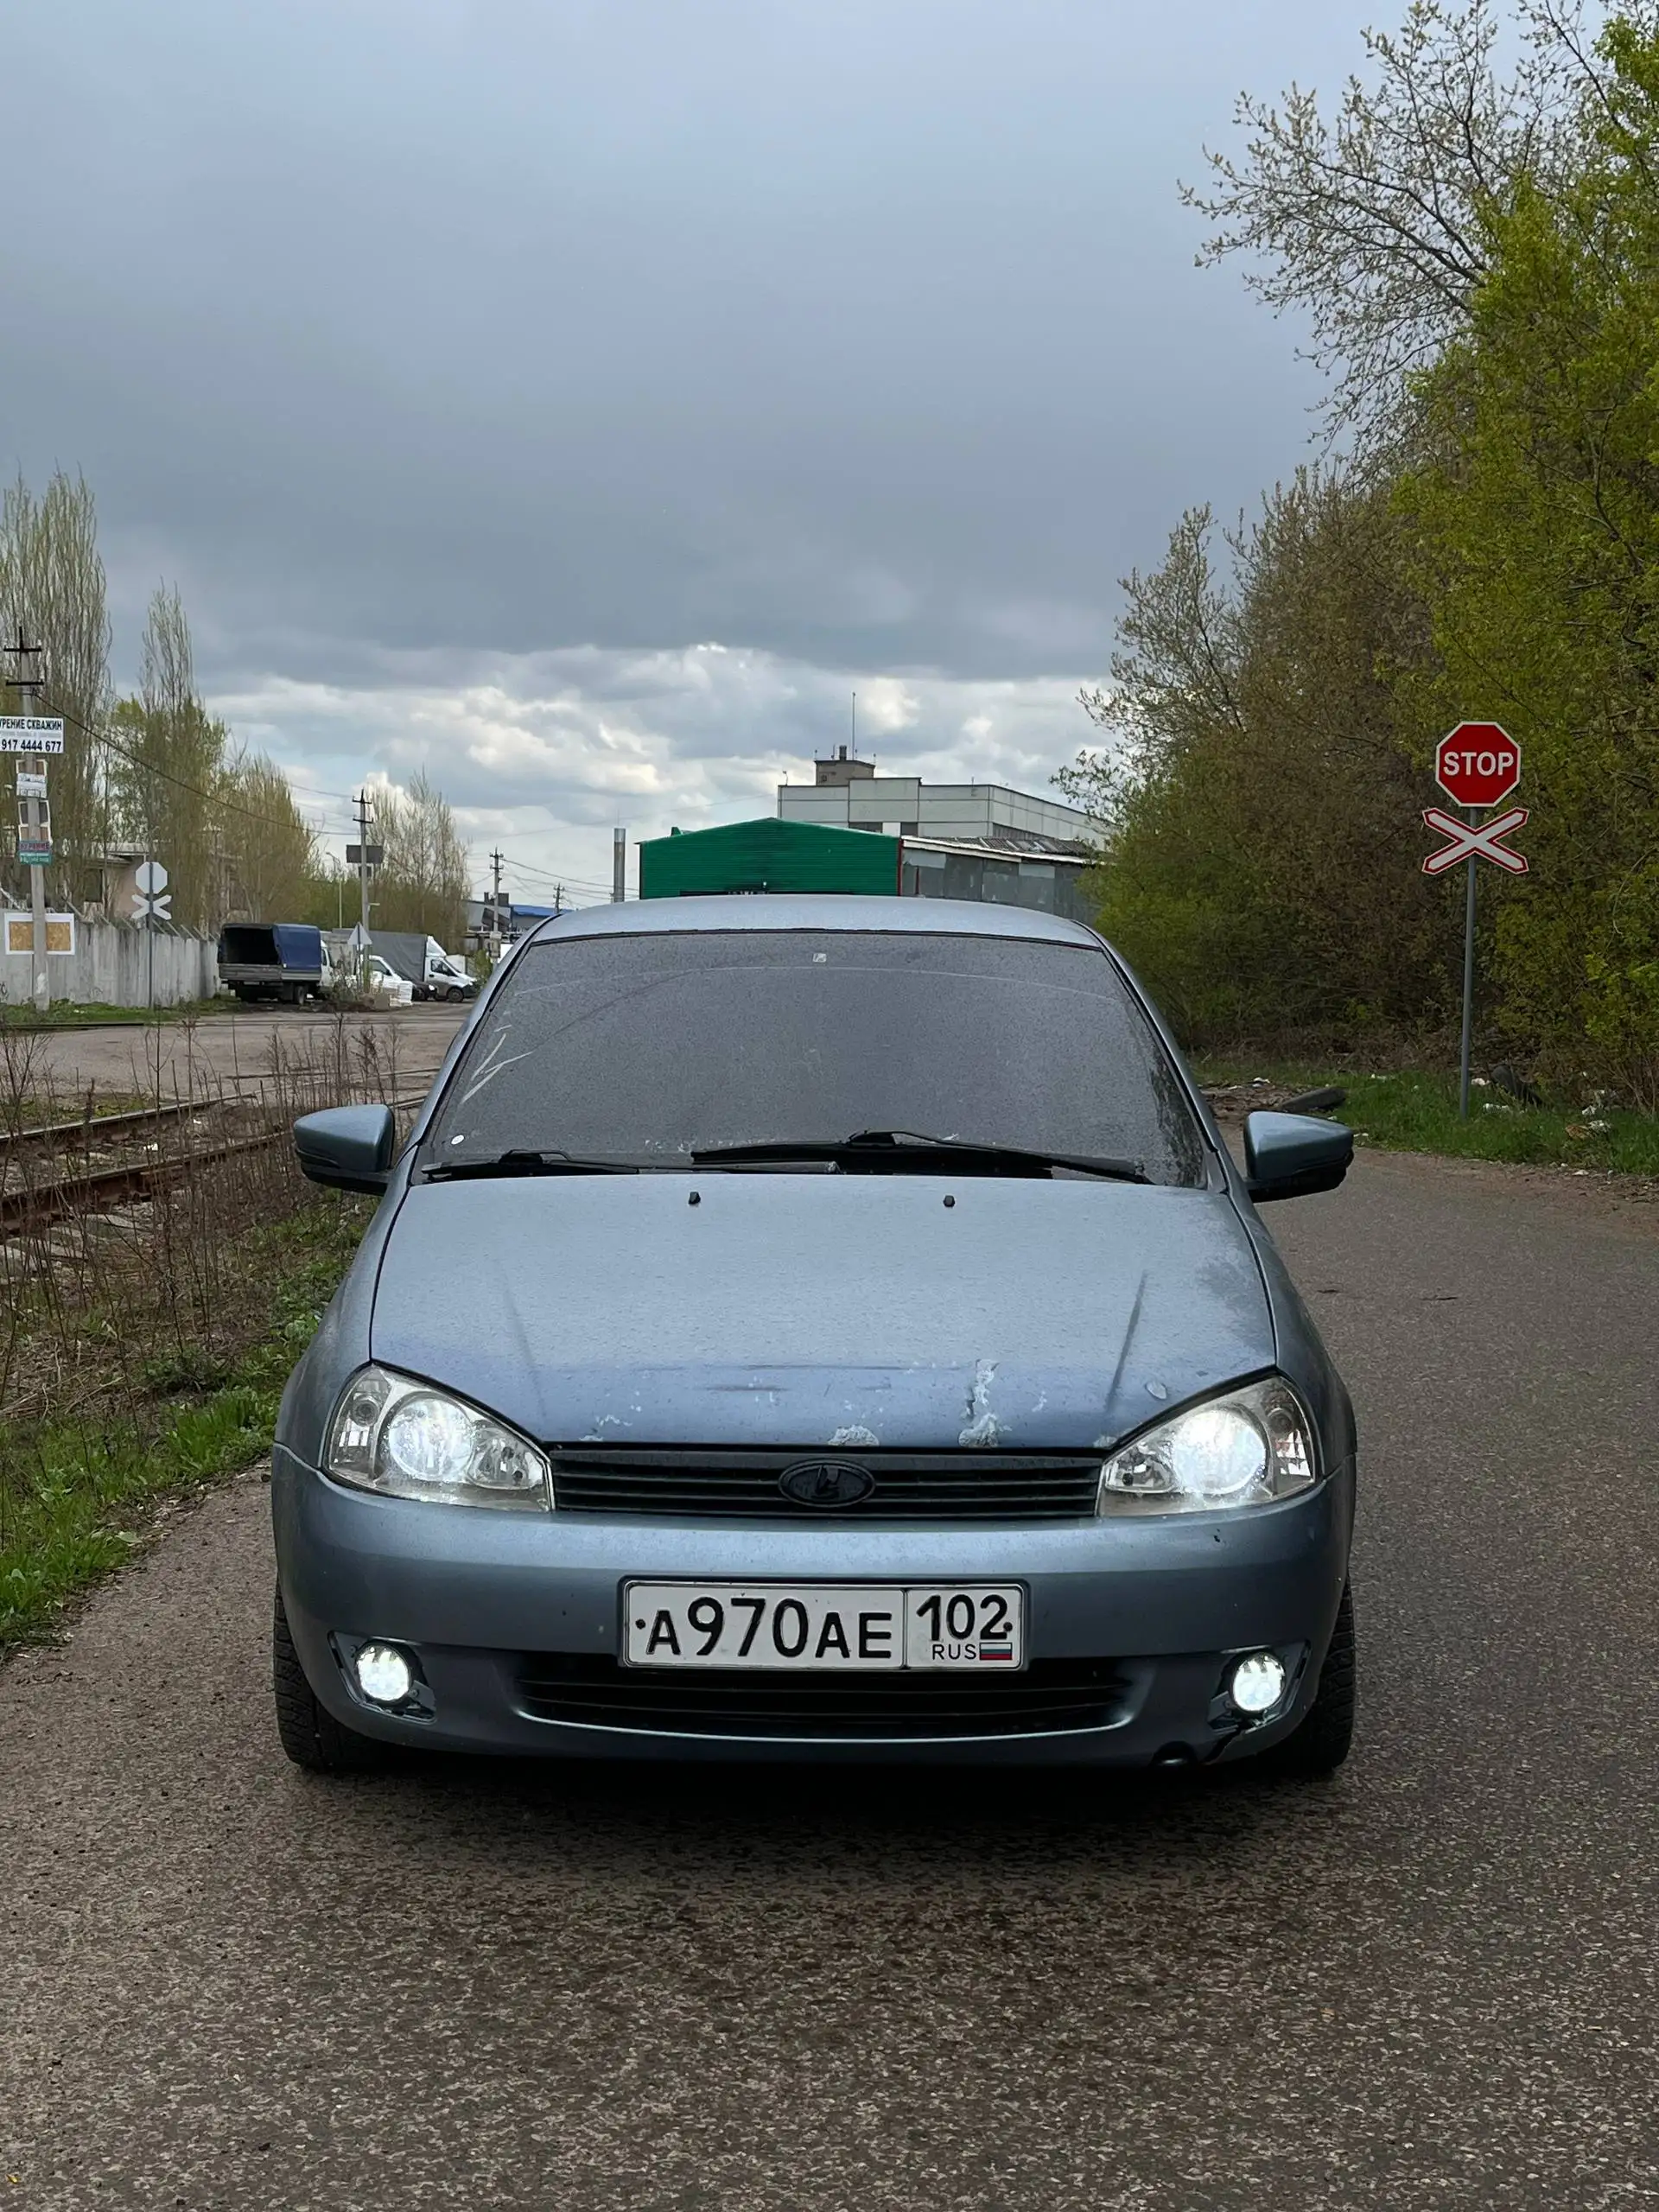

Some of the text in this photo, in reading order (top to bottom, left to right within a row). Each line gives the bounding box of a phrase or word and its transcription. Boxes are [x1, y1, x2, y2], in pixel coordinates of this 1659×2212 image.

[27, 719, 62, 730] СКВАЖИН
[2, 739, 61, 752] 917 4444 677
[1443, 751, 1514, 776] STOP
[645, 1596, 893, 1658] А970АЕ
[916, 1593, 1008, 1641] 102
[931, 1643, 977, 1660] RUS
